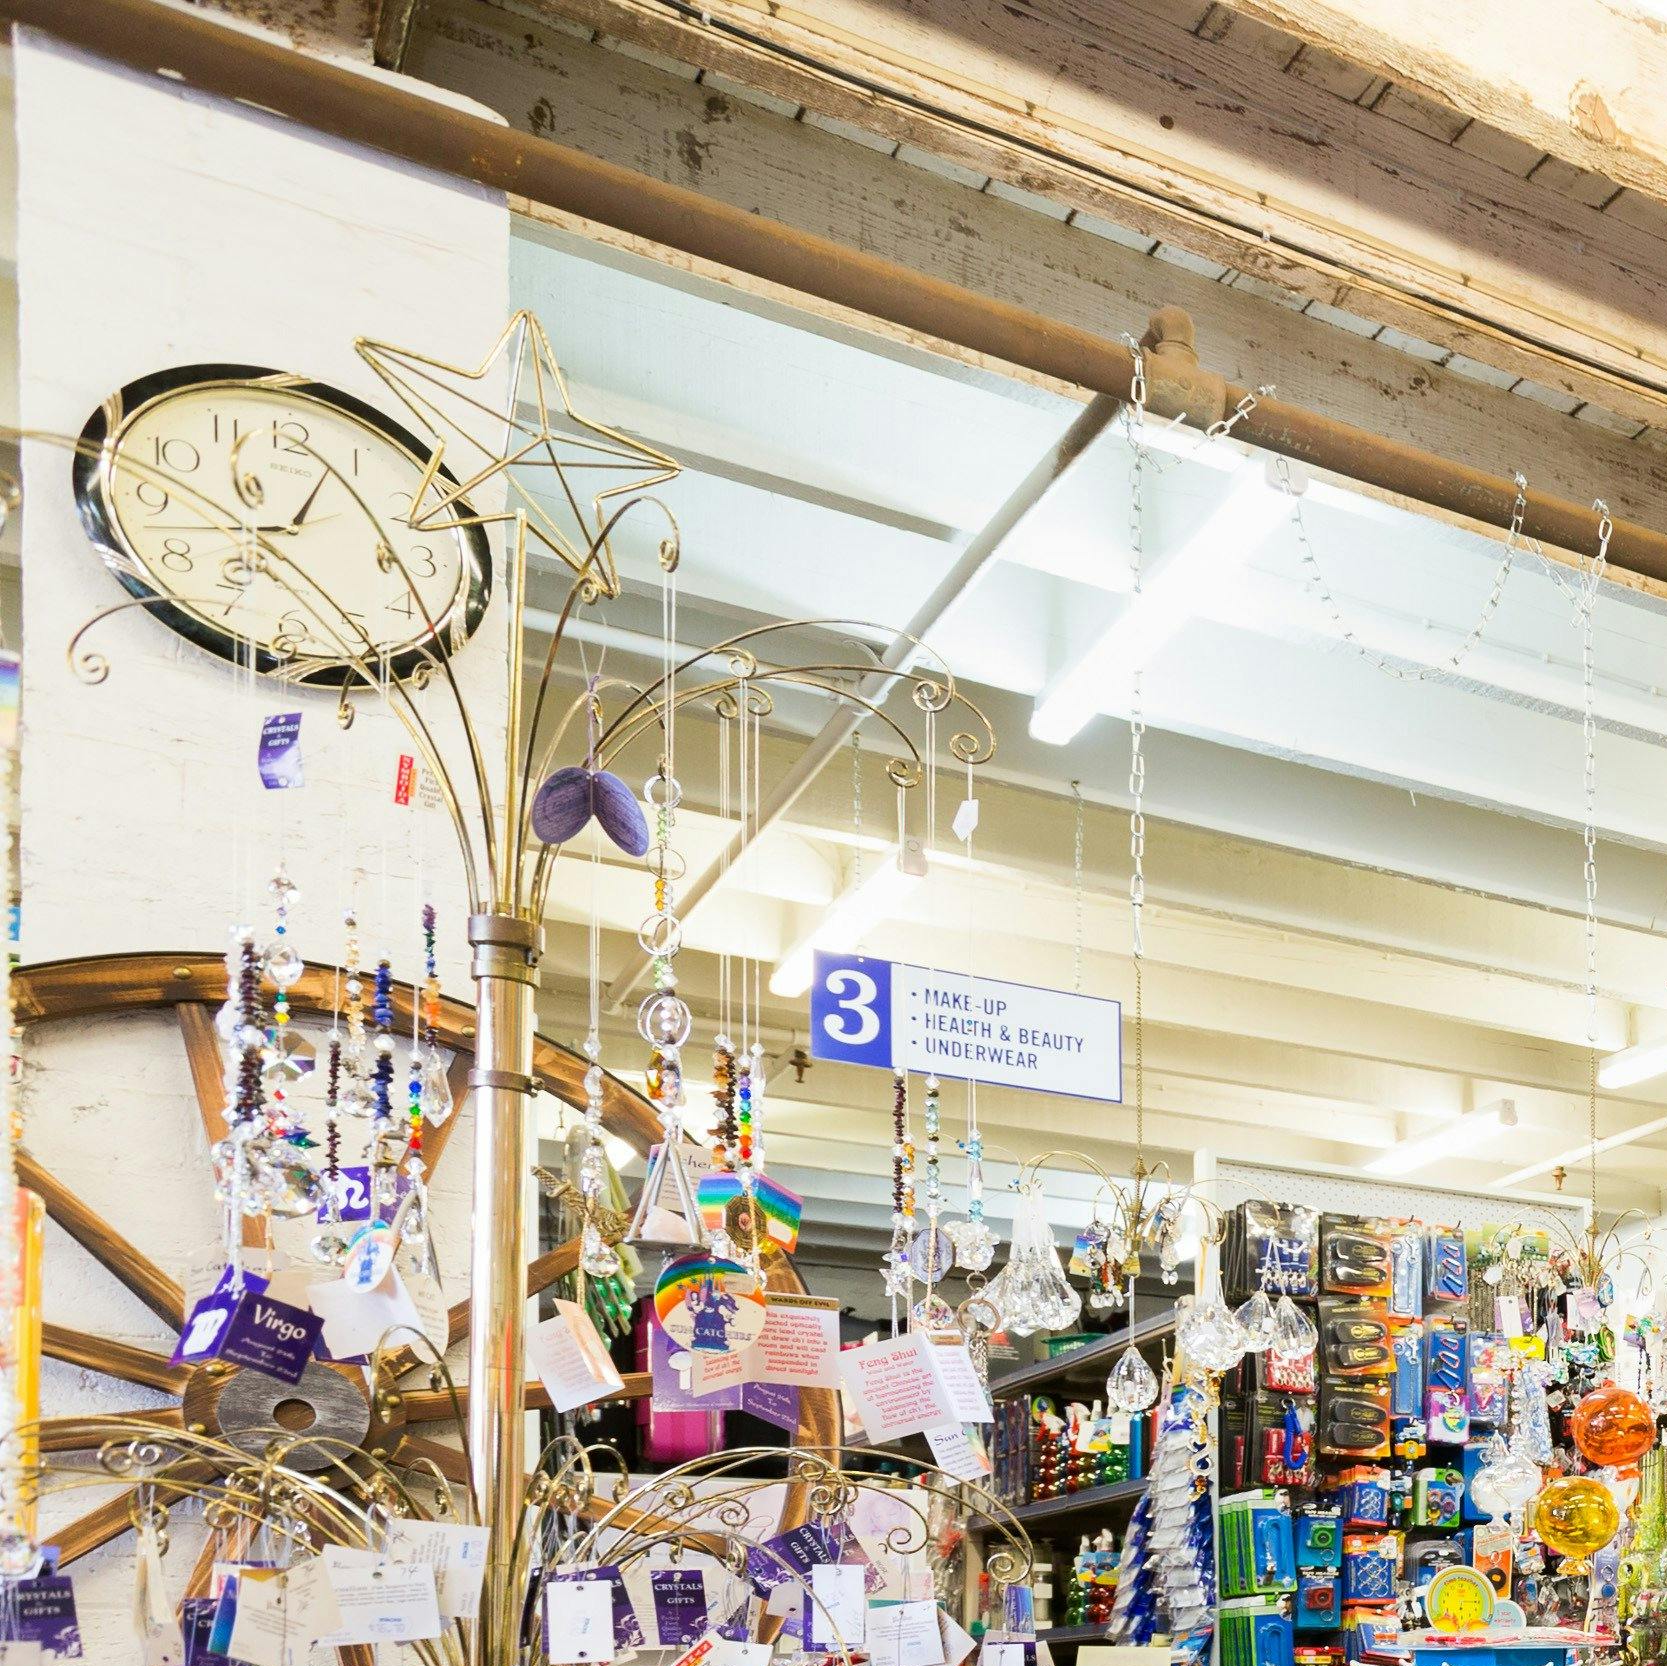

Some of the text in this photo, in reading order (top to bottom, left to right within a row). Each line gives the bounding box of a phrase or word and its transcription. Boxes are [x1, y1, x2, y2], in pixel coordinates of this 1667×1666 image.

[214, 414, 237, 443] 11
[273, 420, 309, 456] 12
[156, 437, 200, 472] 10
[353, 448, 358, 476] 1
[136, 481, 168, 516] 9
[162, 538, 193, 572] 8
[408, 545, 437, 578] 3
[384, 590, 415, 620] 4
[823, 968, 881, 1046] 3
[924, 987, 1008, 1017] MAKE-UP
[924, 1011, 1085, 1055] HEALTH & BEAUTY
[924, 1039, 1038, 1071] UNDERWEAR
[254, 1303, 307, 1342] Virgo
[858, 1346, 919, 1370] Feng Shui
[912, 1367, 923, 1377] the
[923, 1380, 935, 1389] the
[789, 1540, 811, 1564] GIFTS
[799, 1527, 832, 1564] CRYSTALS
[654, 1582, 703, 1592] CRYSTALS
[666, 1597, 696, 1605] GIFTS
[23, 1605, 60, 1616] GIFTS
